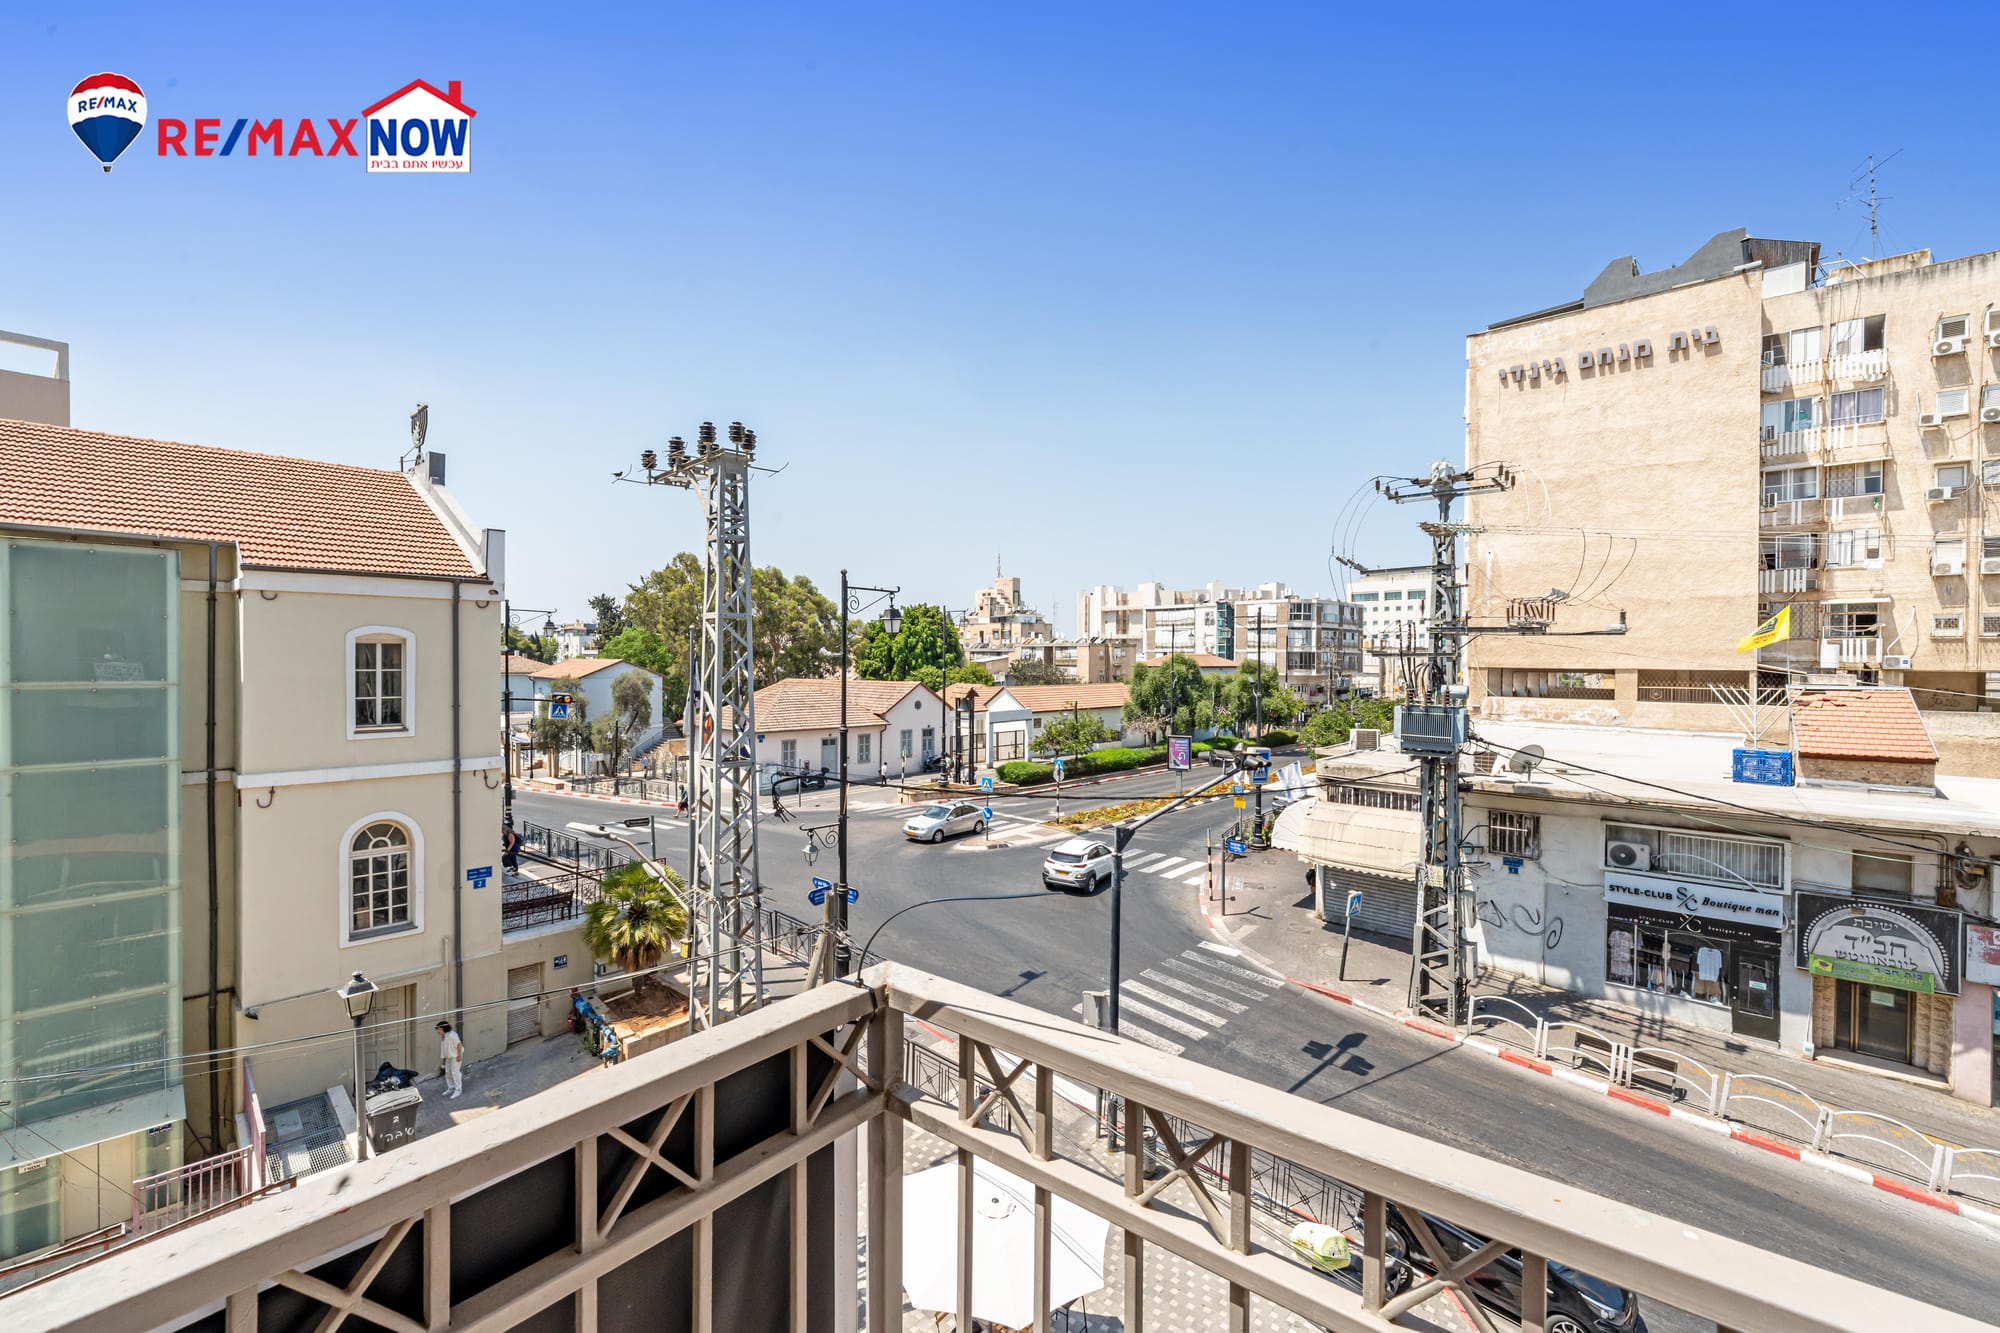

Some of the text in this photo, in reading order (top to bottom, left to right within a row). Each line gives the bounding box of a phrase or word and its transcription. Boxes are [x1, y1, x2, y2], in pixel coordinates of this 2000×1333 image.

[1498, 325, 1721, 383] בית מנחם גינדי
[1608, 884, 1674, 901] STYLE-CLUB
[1701, 896, 1752, 913] Boutique
[1754, 906, 1780, 917] man
[1852, 918, 1899, 931] ישיבת
